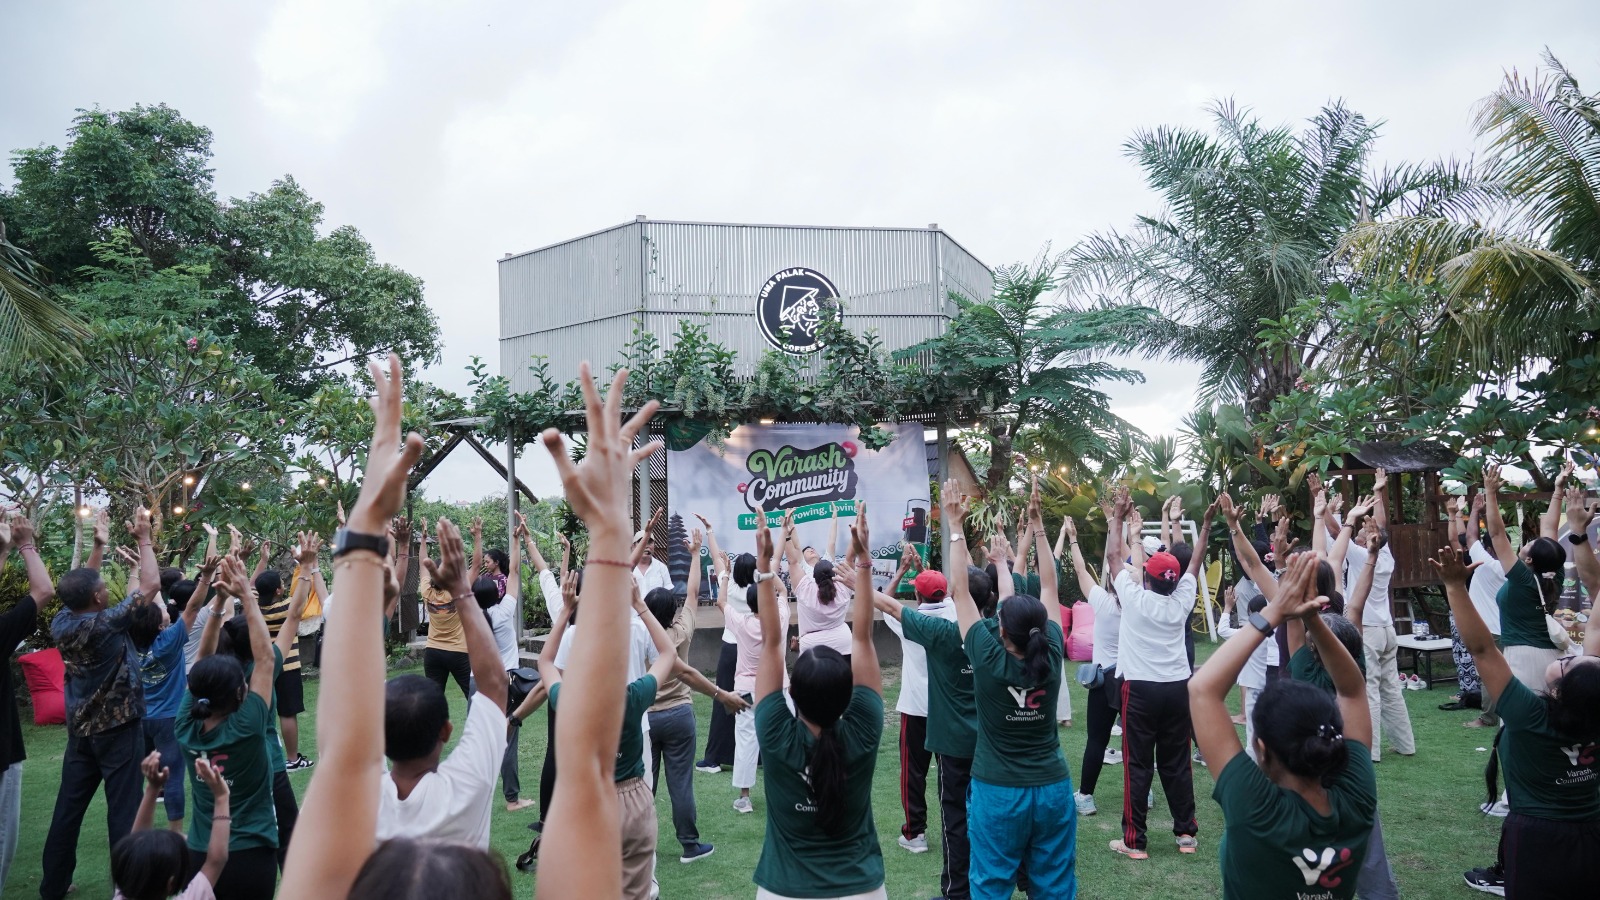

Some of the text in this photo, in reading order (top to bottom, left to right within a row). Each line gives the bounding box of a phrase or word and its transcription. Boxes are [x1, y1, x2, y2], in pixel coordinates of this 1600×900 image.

[761, 268, 805, 298] UMA PALAK
[782, 343, 817, 352] COFFEE
[748, 444, 847, 483] Varash
[746, 468, 849, 509] Community
[744, 515, 782, 526] Heing
[793, 507, 828, 520] rowing,
[1005, 713, 1046, 722] Community
[1566, 767, 1592, 778] Varash
